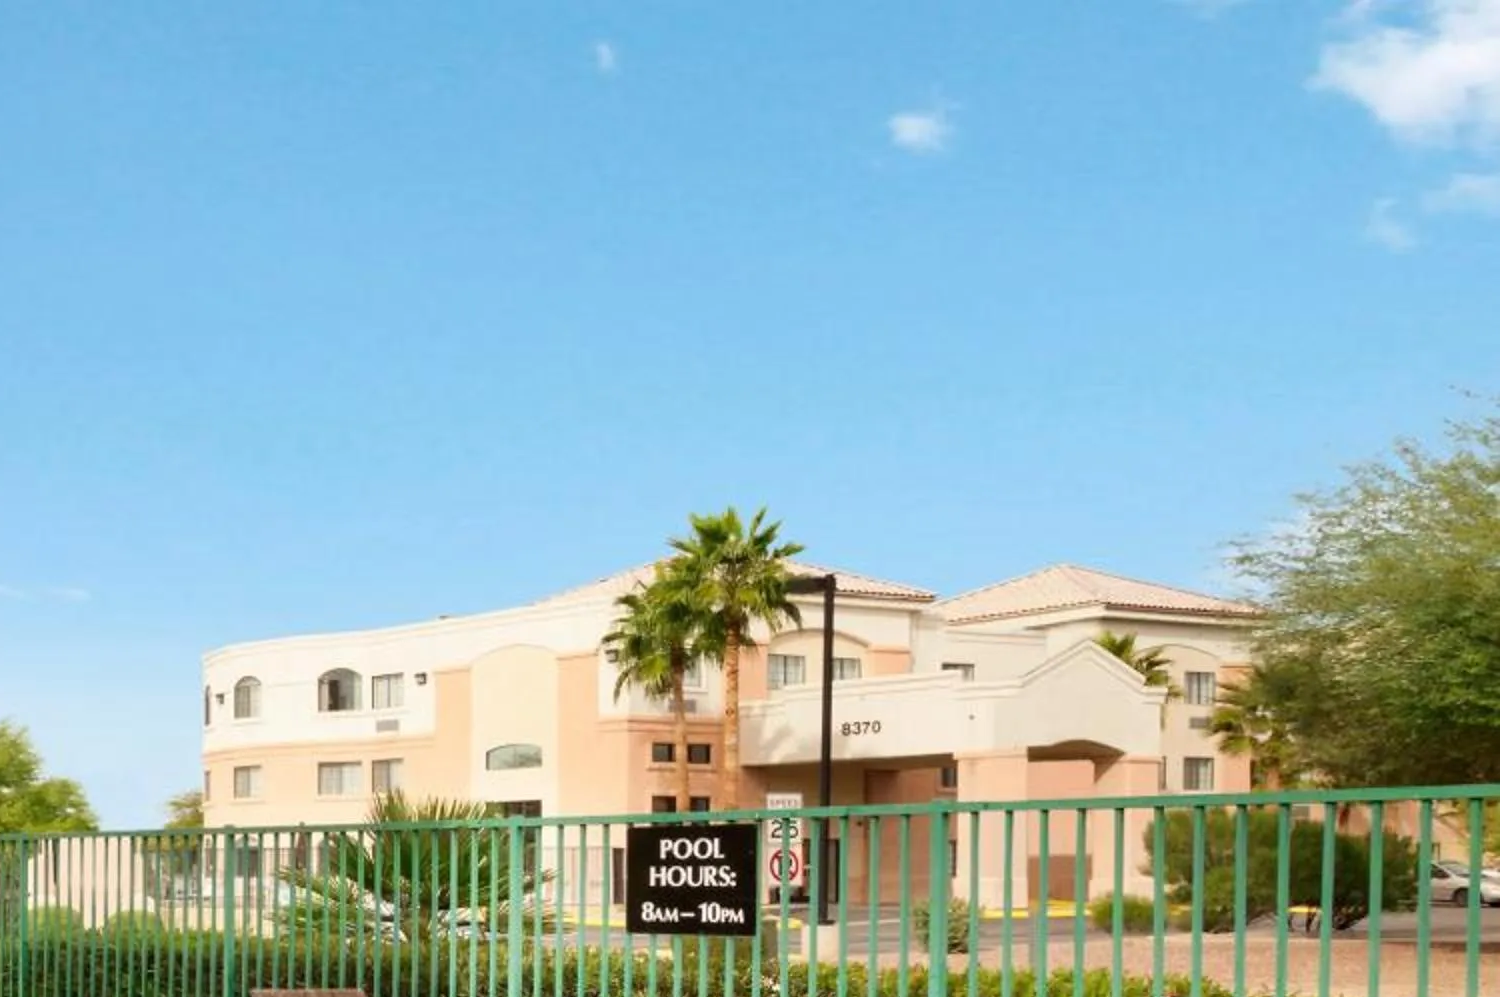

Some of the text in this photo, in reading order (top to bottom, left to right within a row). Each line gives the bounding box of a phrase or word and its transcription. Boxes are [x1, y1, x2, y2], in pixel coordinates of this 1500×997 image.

[842, 720, 882, 737] 8370
[660, 838, 725, 859] POOL
[649, 865, 737, 887] HOURS:
